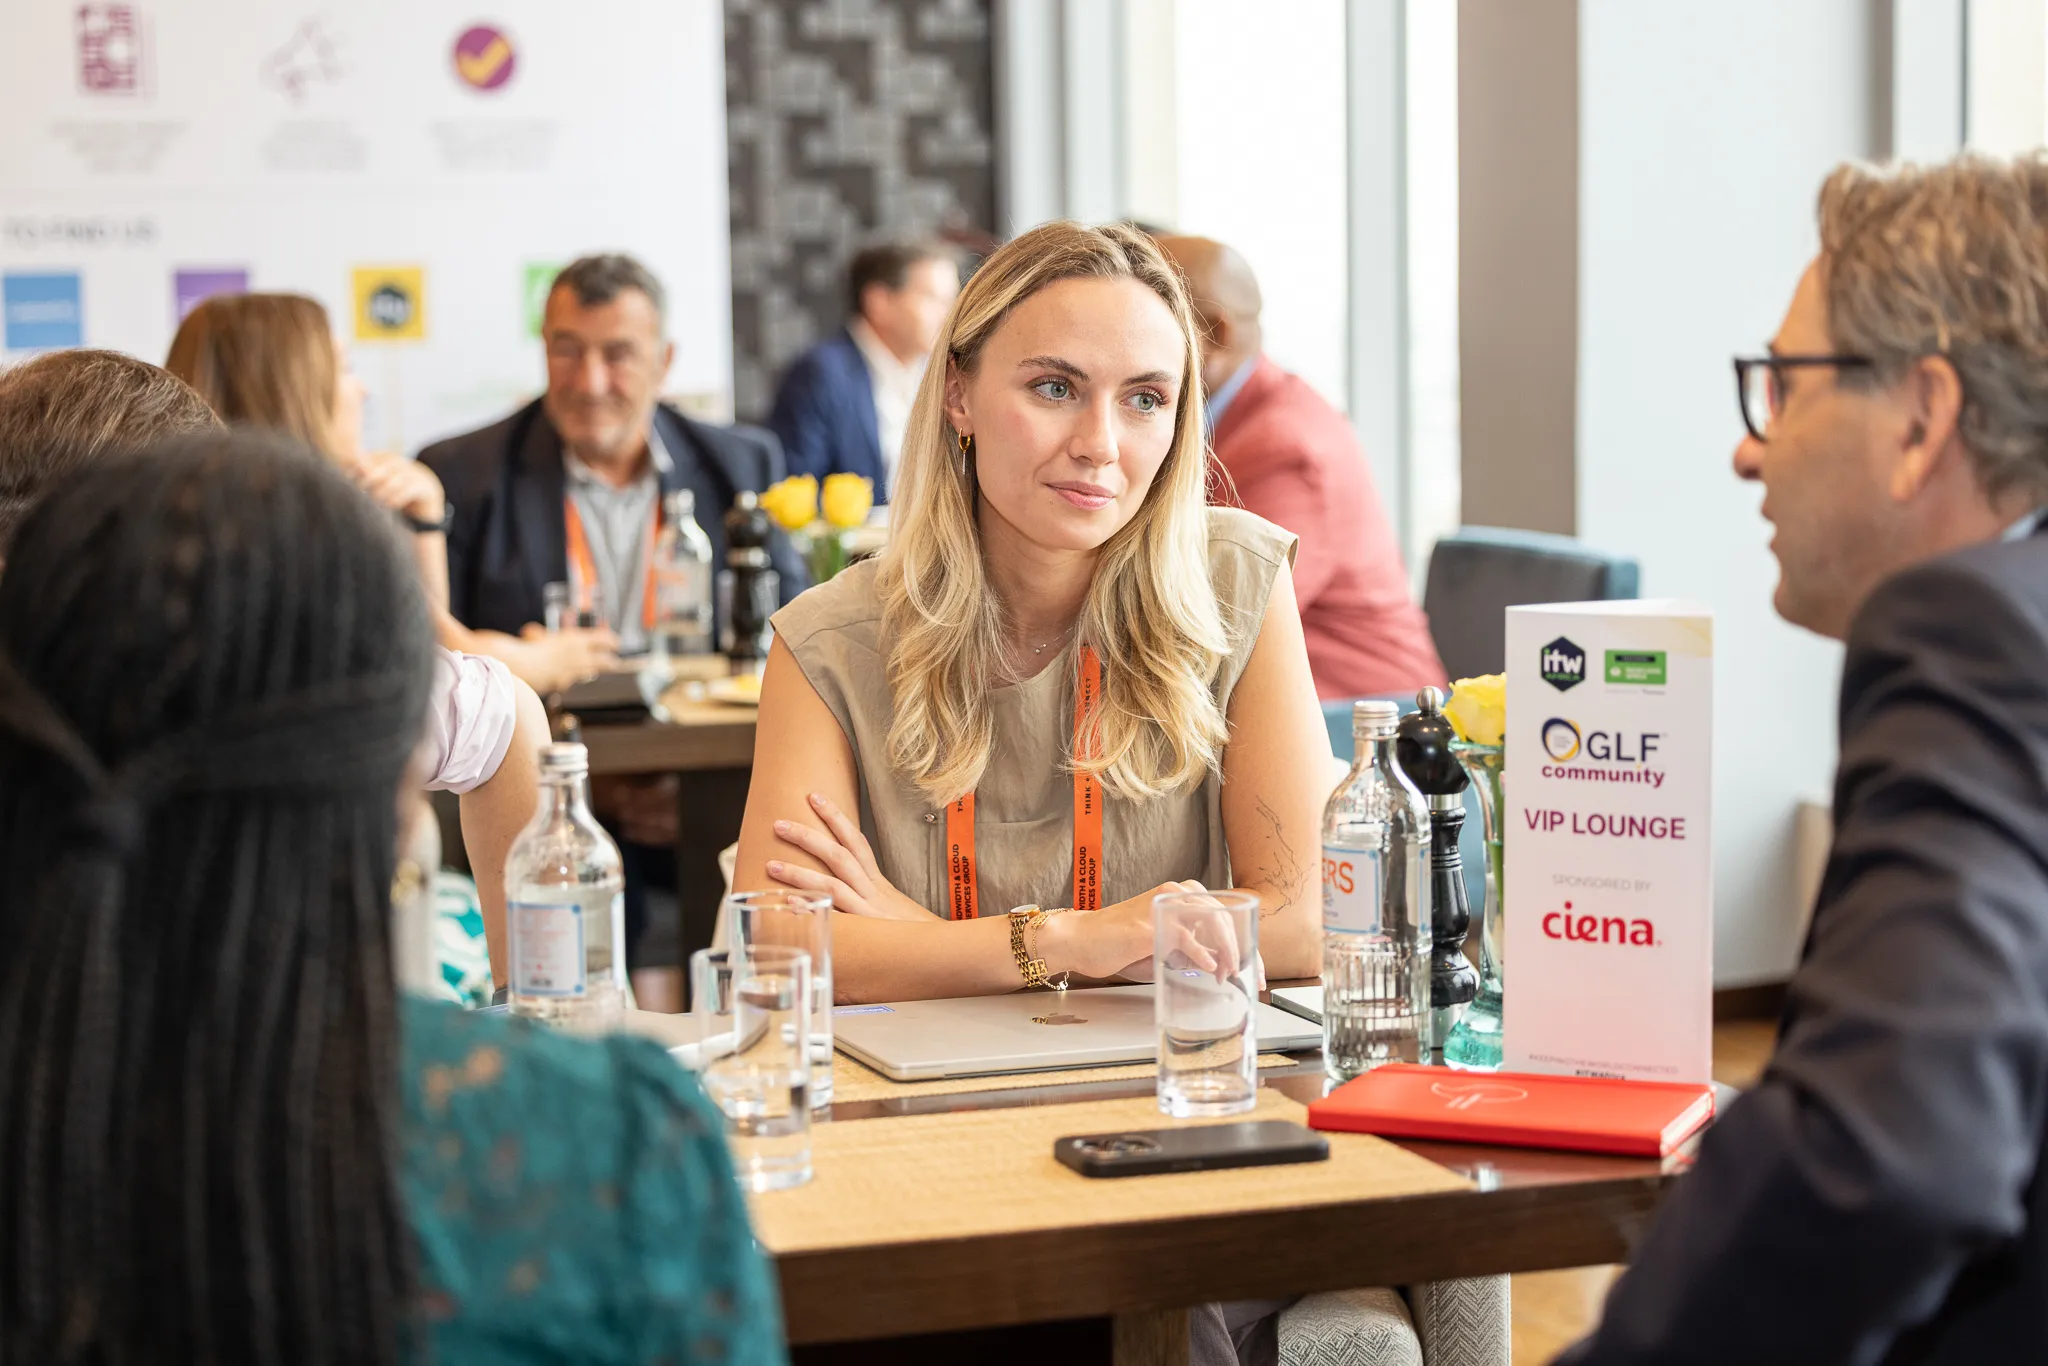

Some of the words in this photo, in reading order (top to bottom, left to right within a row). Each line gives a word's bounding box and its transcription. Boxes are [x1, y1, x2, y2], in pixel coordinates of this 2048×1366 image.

[1587, 731, 1660, 762] GLF
[1542, 765, 1665, 788] community
[1525, 808, 1565, 832] VIP
[1572, 812, 1685, 840] LOUNGE
[953, 844, 961, 873] CLOUD
[963, 856, 971, 884] GROUP
[1079, 846, 1087, 876] CLOUD
[1552, 875, 1631, 891] SPONSORED
[1635, 880, 1651, 892] BY
[1542, 900, 1654, 947] ciena
